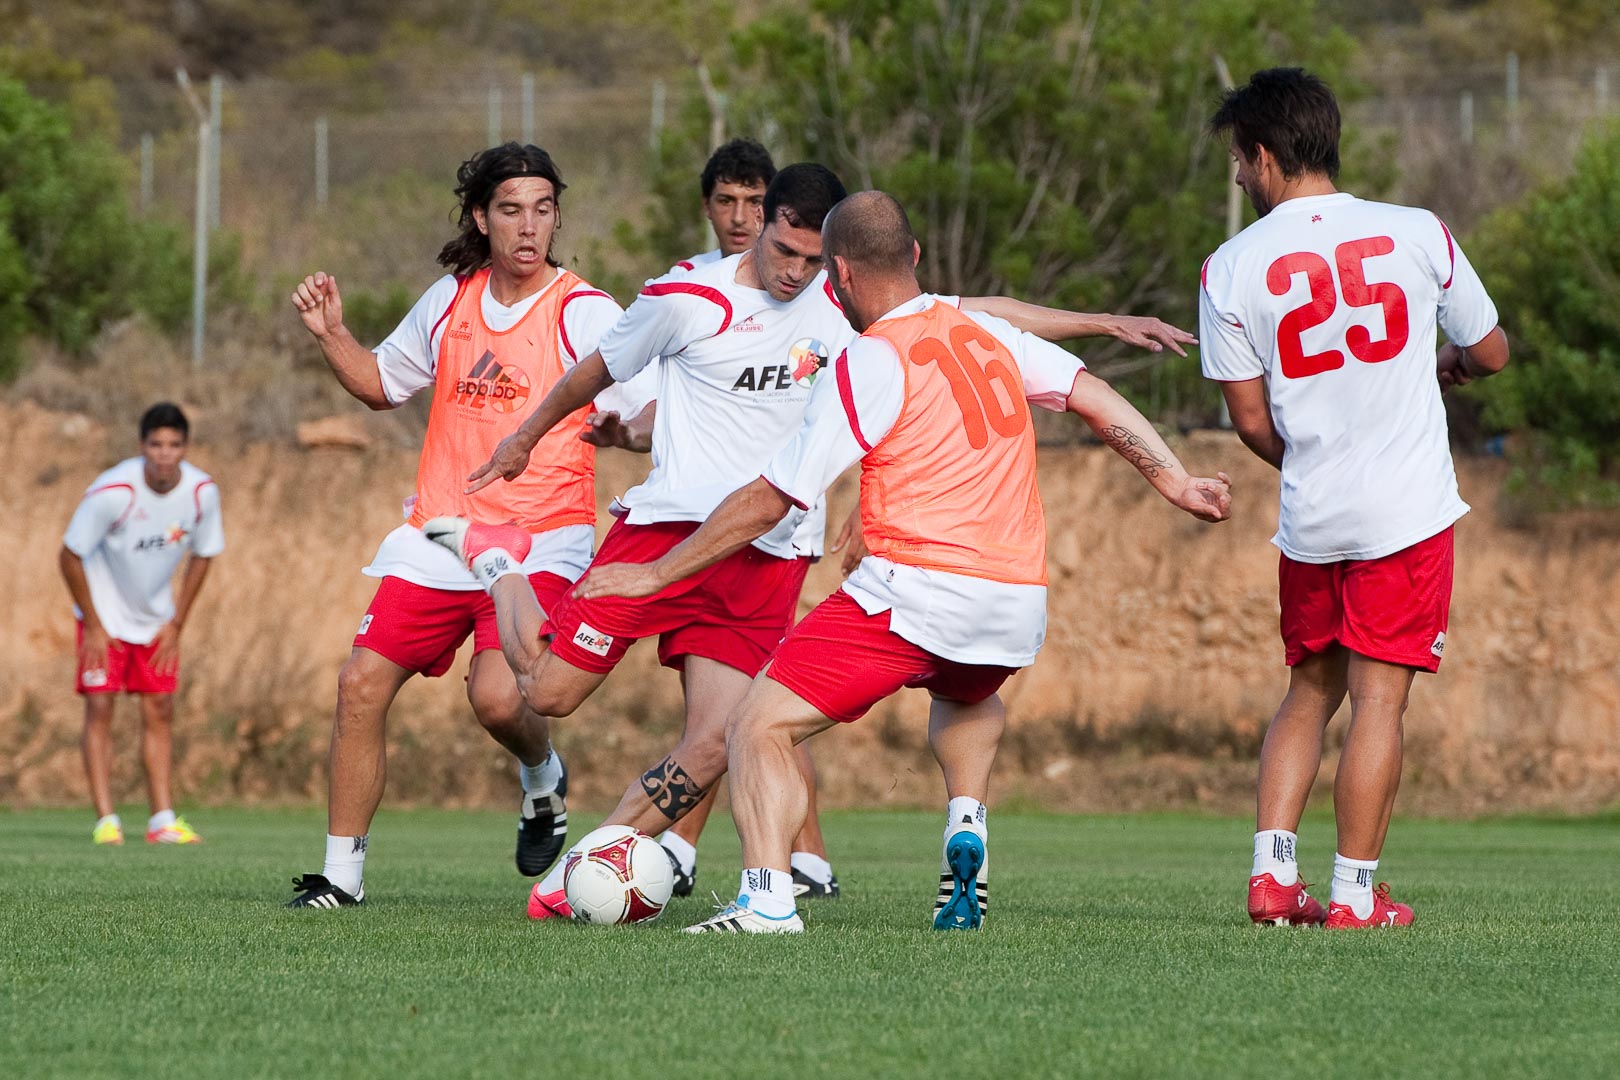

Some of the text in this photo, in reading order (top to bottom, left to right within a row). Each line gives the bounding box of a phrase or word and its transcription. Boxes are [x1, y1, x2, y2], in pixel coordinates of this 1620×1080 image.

[1266, 236, 1409, 379] 25
[731, 365, 792, 391] AFE
[909, 325, 1027, 450] 16
[576, 632, 595, 646] AFE
